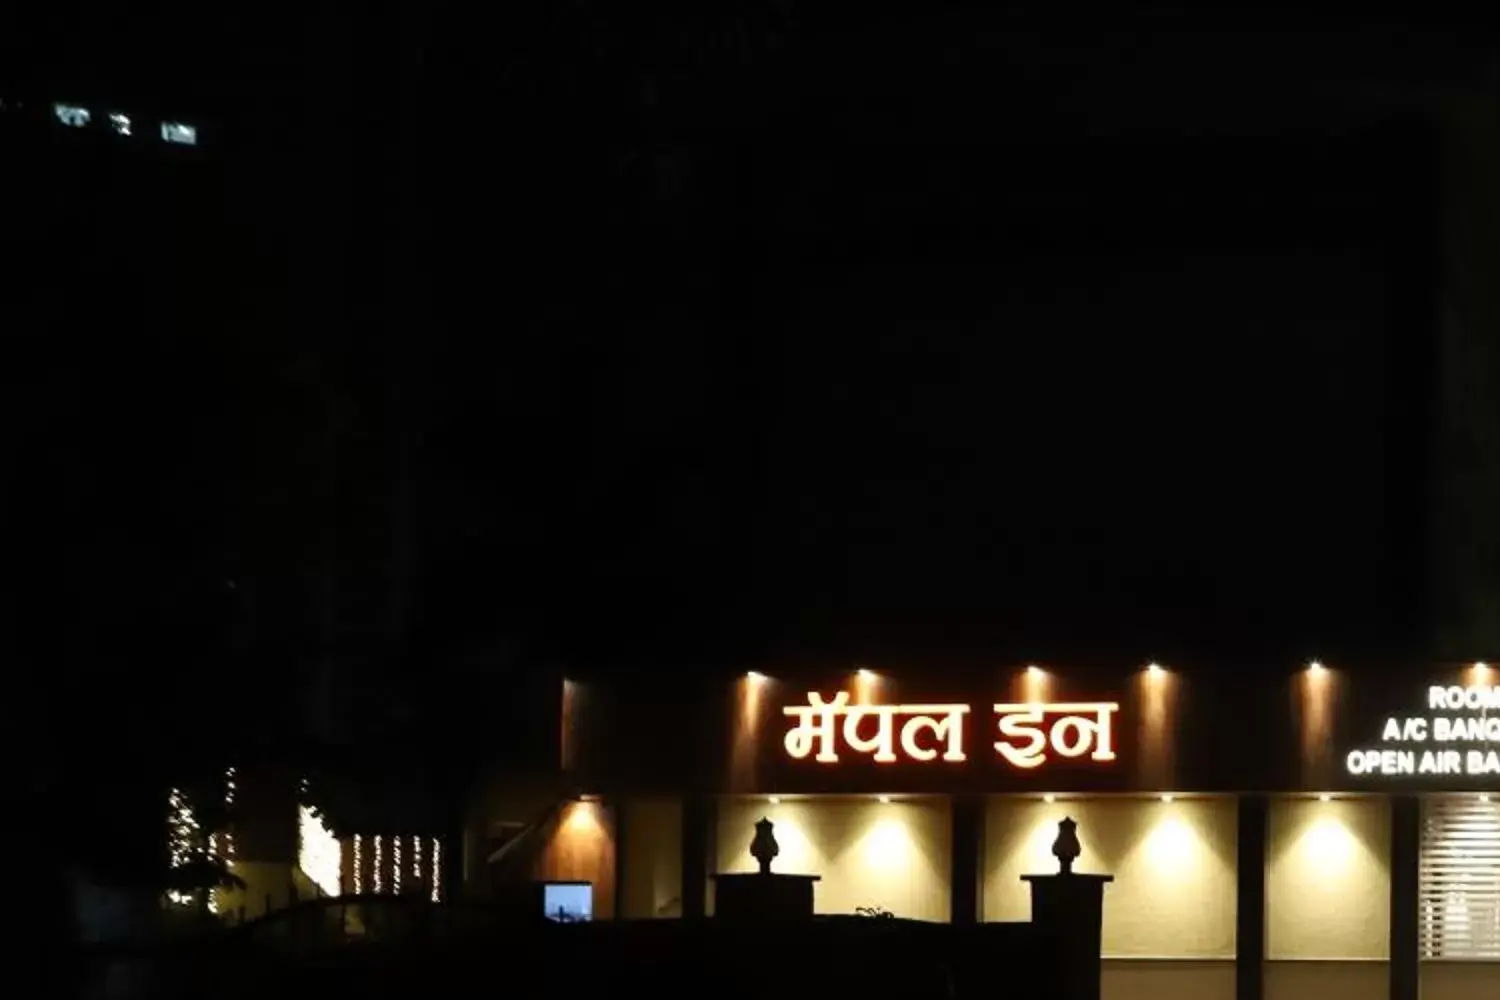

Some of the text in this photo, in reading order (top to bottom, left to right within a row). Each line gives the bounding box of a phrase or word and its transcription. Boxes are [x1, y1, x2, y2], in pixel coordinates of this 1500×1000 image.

[993, 702, 1119, 769] इन
[1382, 717, 1427, 741] A/C
[1347, 750, 1414, 774] OPEN
[1418, 750, 1460, 774] AIR
